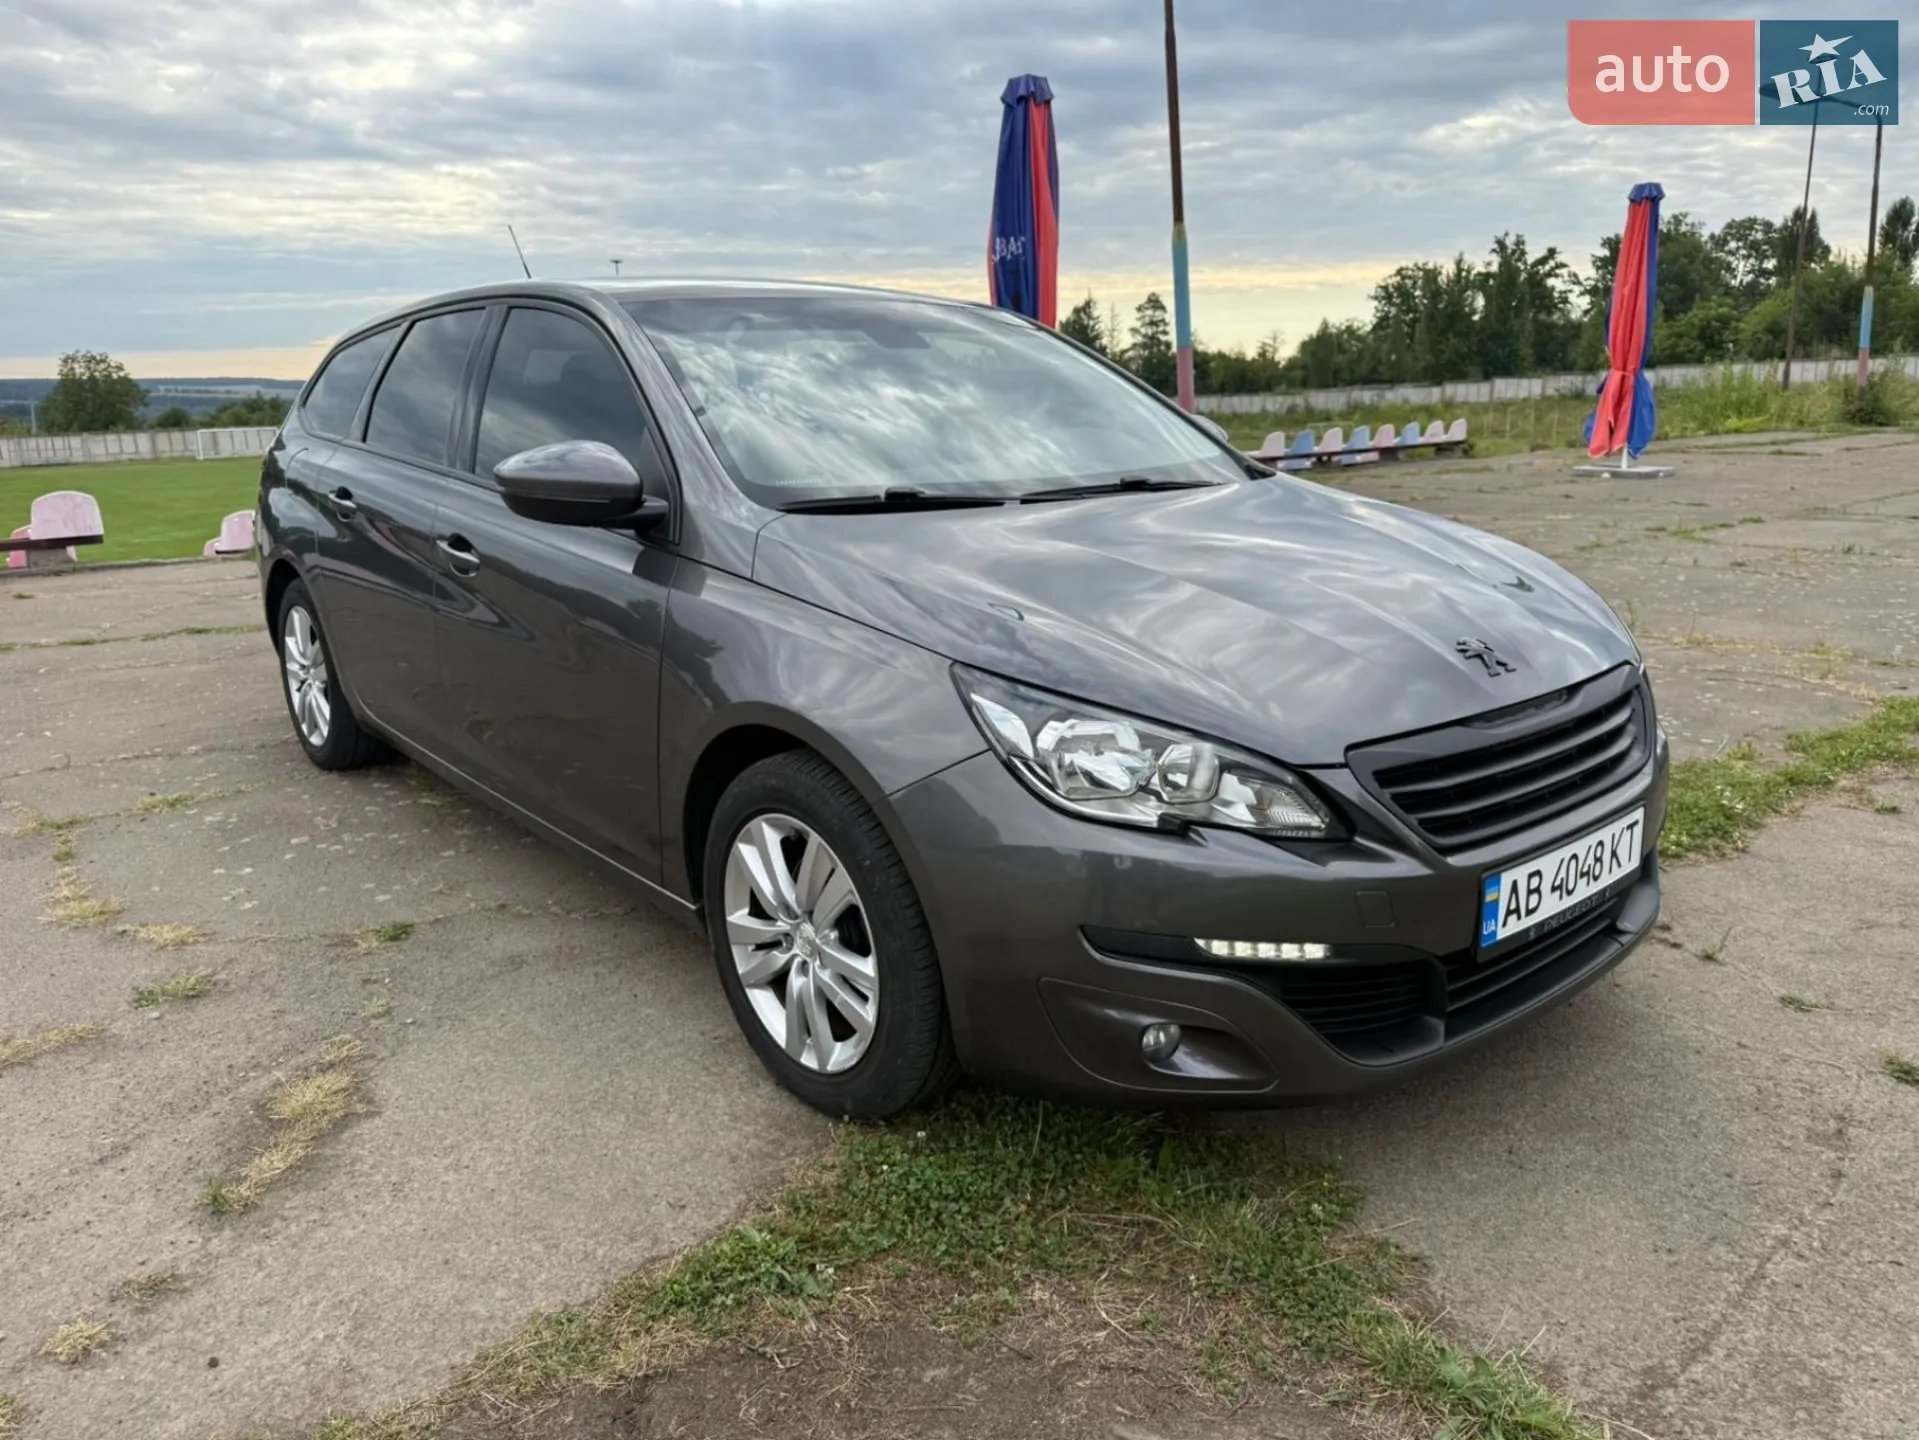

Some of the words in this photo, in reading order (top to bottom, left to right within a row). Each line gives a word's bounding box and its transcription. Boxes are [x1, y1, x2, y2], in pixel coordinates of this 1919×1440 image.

[1502, 869, 1543, 927] AB
[1551, 840, 1604, 901] 4048
[1609, 819, 1639, 875] KT
[1482, 920, 1497, 935] UA
